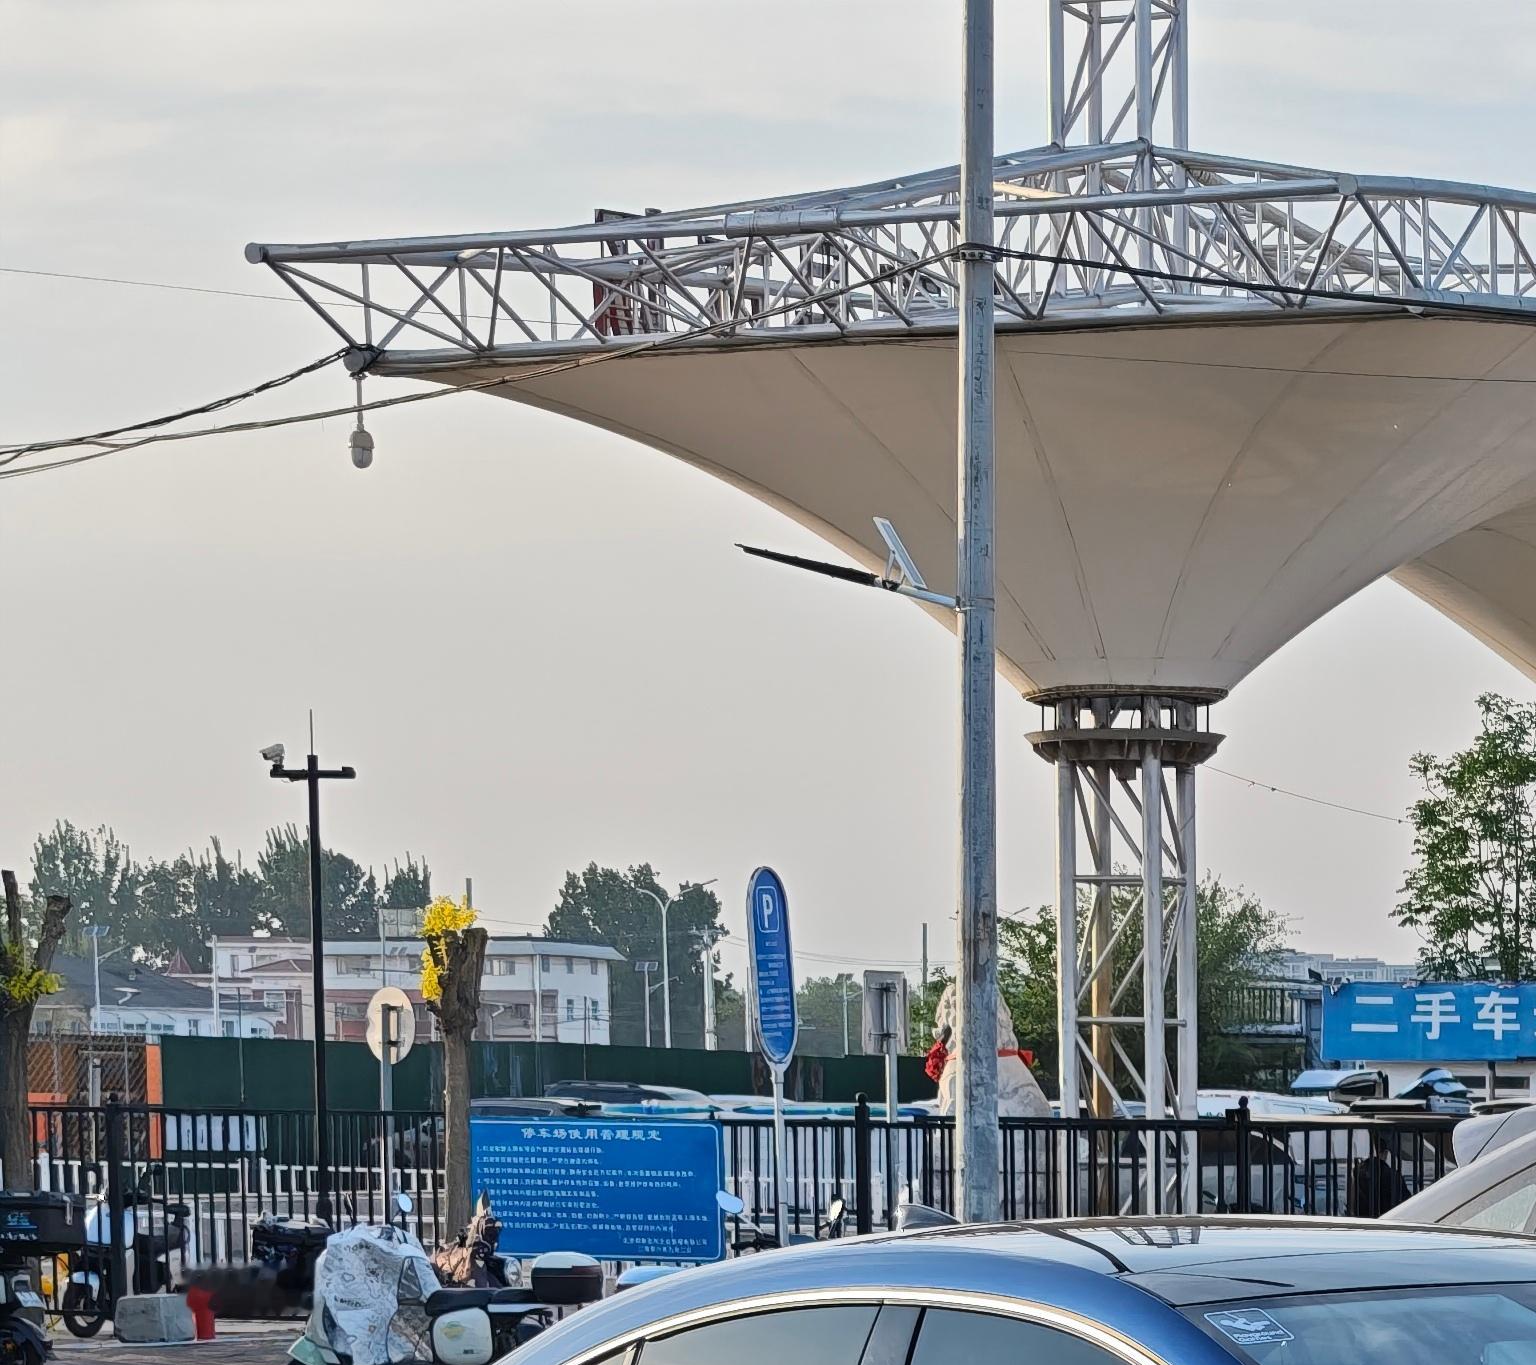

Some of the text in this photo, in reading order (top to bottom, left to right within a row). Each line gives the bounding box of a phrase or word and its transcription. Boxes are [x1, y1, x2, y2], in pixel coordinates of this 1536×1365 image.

[762, 893, 773, 929] P
[520, 1127, 662, 1141] 停车场使用管理规定
